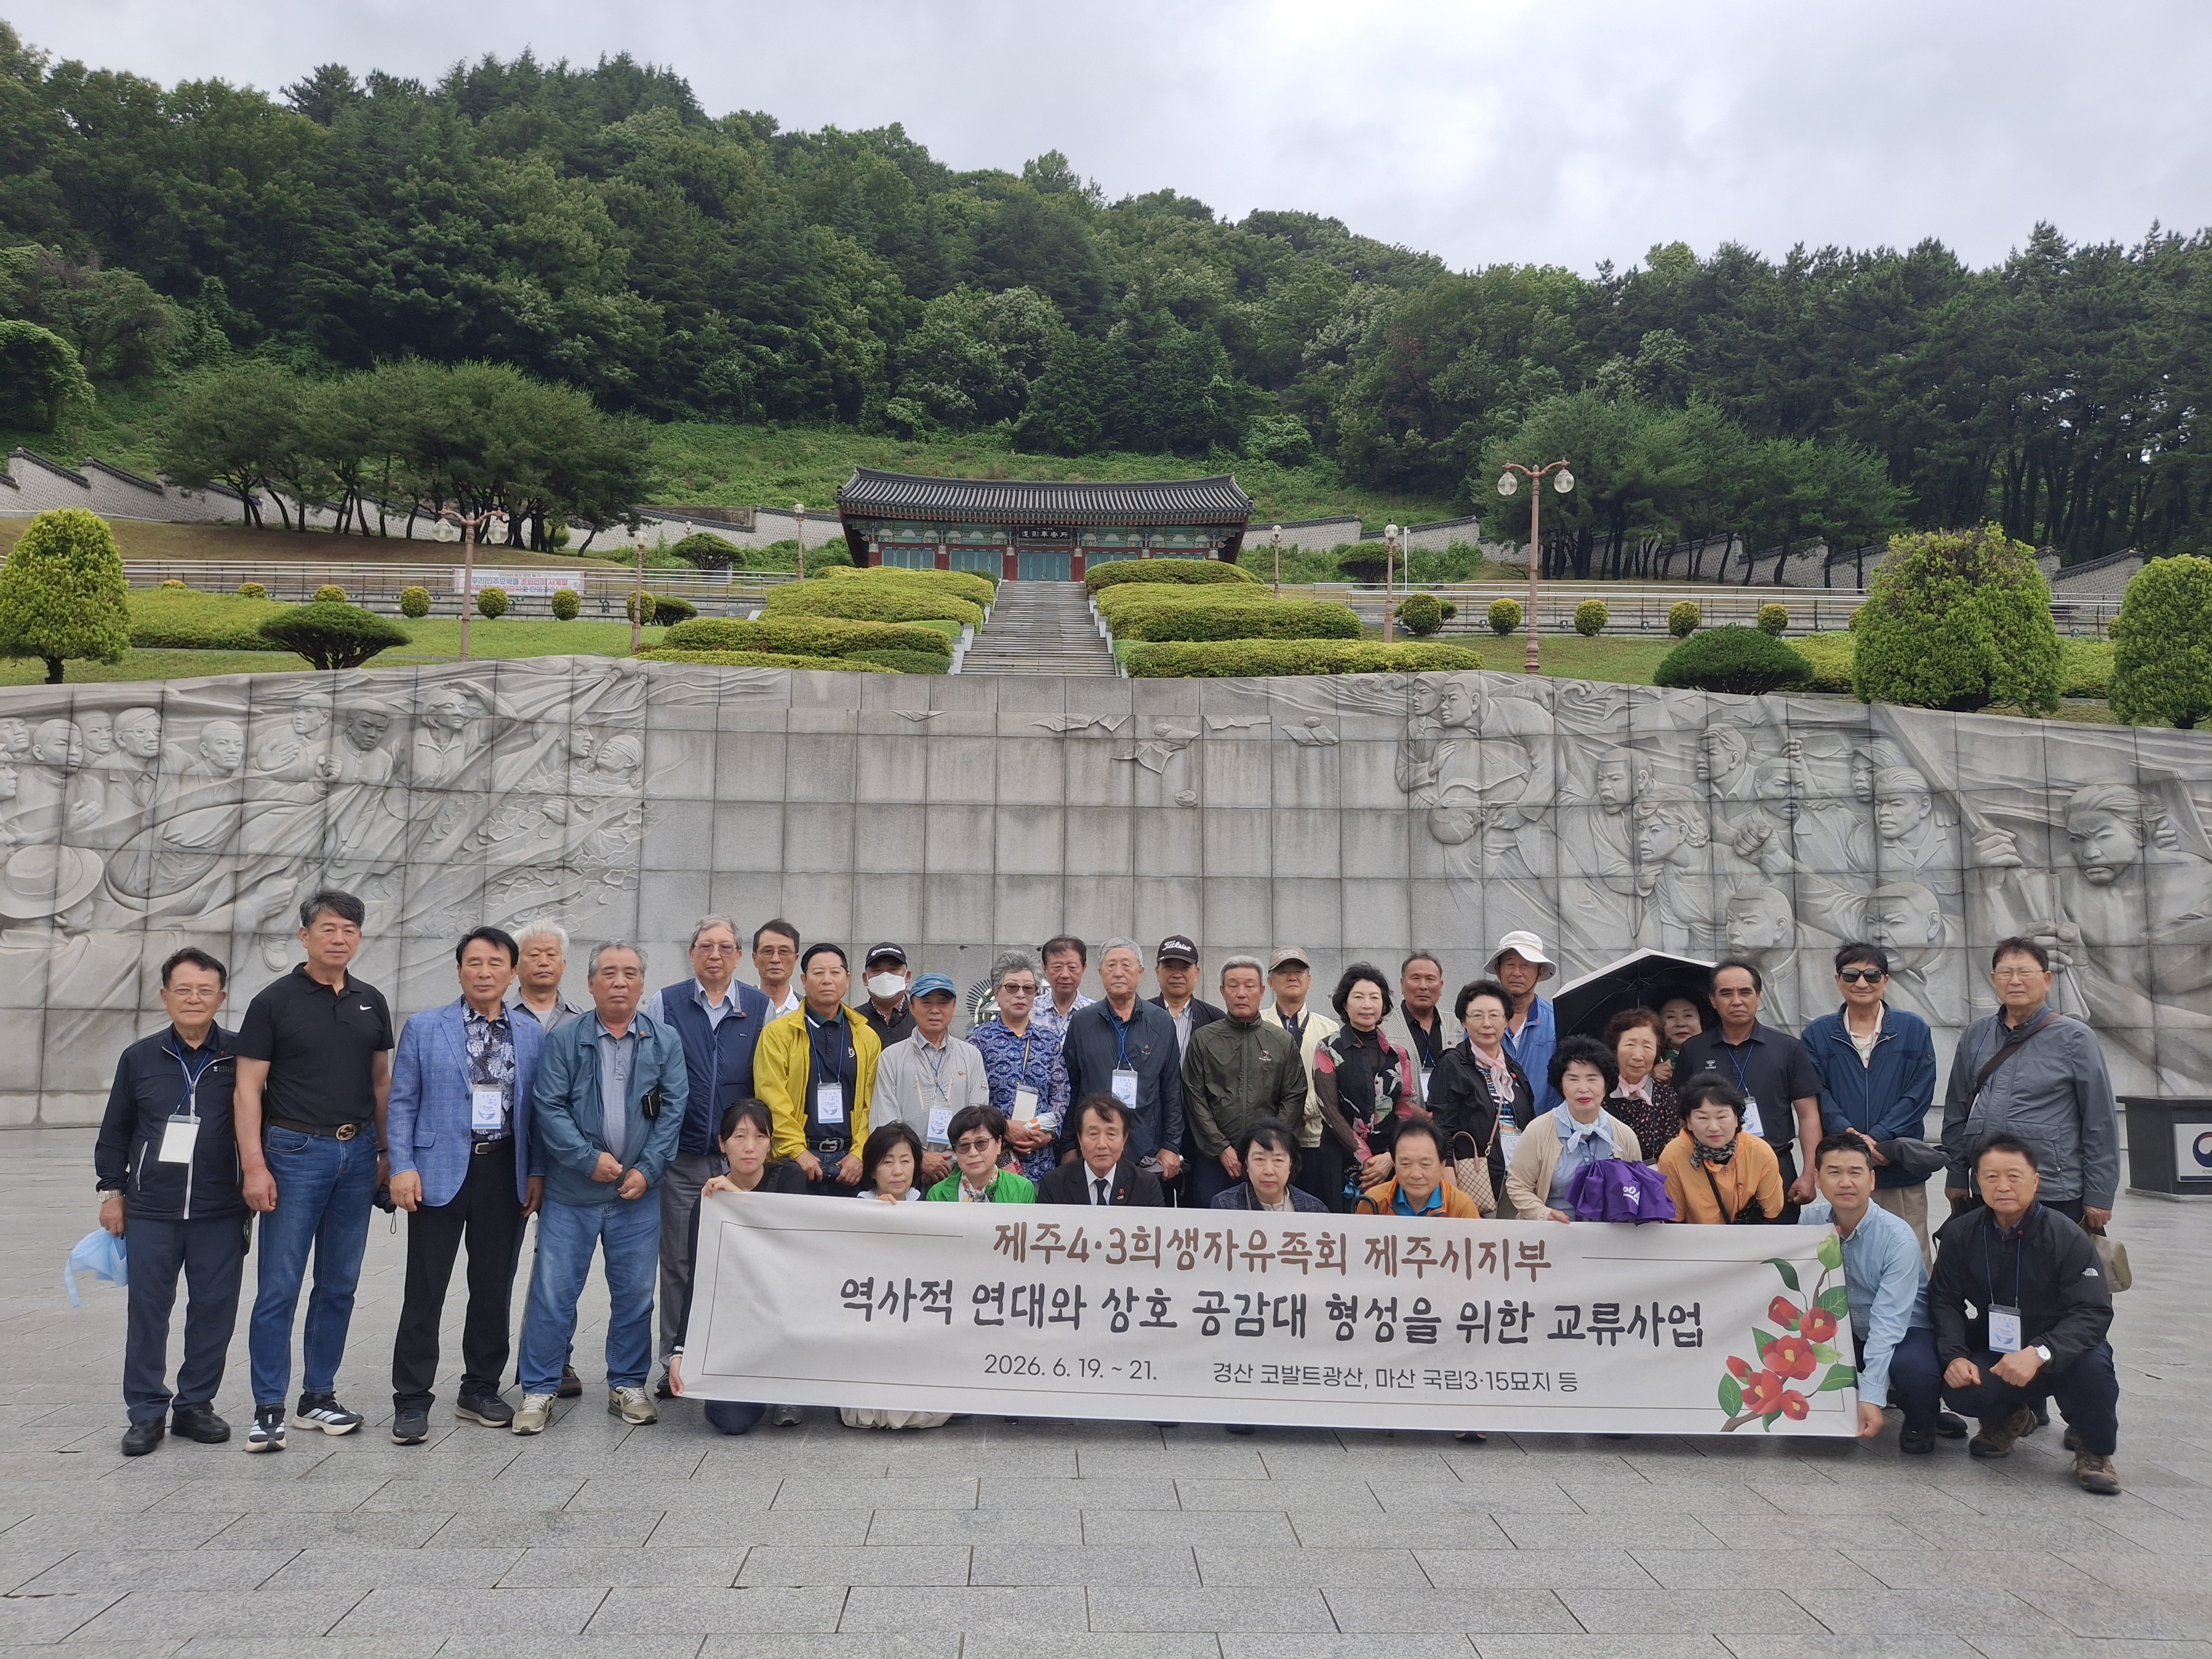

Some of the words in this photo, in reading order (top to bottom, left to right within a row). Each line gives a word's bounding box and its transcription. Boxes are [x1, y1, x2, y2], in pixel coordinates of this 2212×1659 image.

[1162, 940, 1192, 951] Titleist
[993, 1221, 1346, 1276] 제주4·3희생자유족회
[1364, 1234, 1552, 1283] 제주시지부
[841, 1277, 953, 1325] 역사적
[972, 1282, 1087, 1330] 연대와
[1101, 1287, 1178, 1333] 상호
[1192, 1291, 1306, 1339] 공감대
[1325, 1293, 1442, 1344] 형성을
[1456, 1300, 1535, 1344] 위한
[1547, 1302, 1703, 1347] 교류사업
[985, 1354, 1045, 1375] 2026.
[1053, 1358, 1070, 1377] 6.
[1079, 1359, 1103, 1378] 19.
[1130, 1360, 1156, 1380] 21.
[1214, 1363, 1253, 1384] 경산
[1261, 1365, 1367, 1390] 코발트광산,
[1376, 1369, 1416, 1388] 마산
[1423, 1370, 1550, 1392] 국립3·15묘지
[1559, 1373, 1578, 1392] 등
